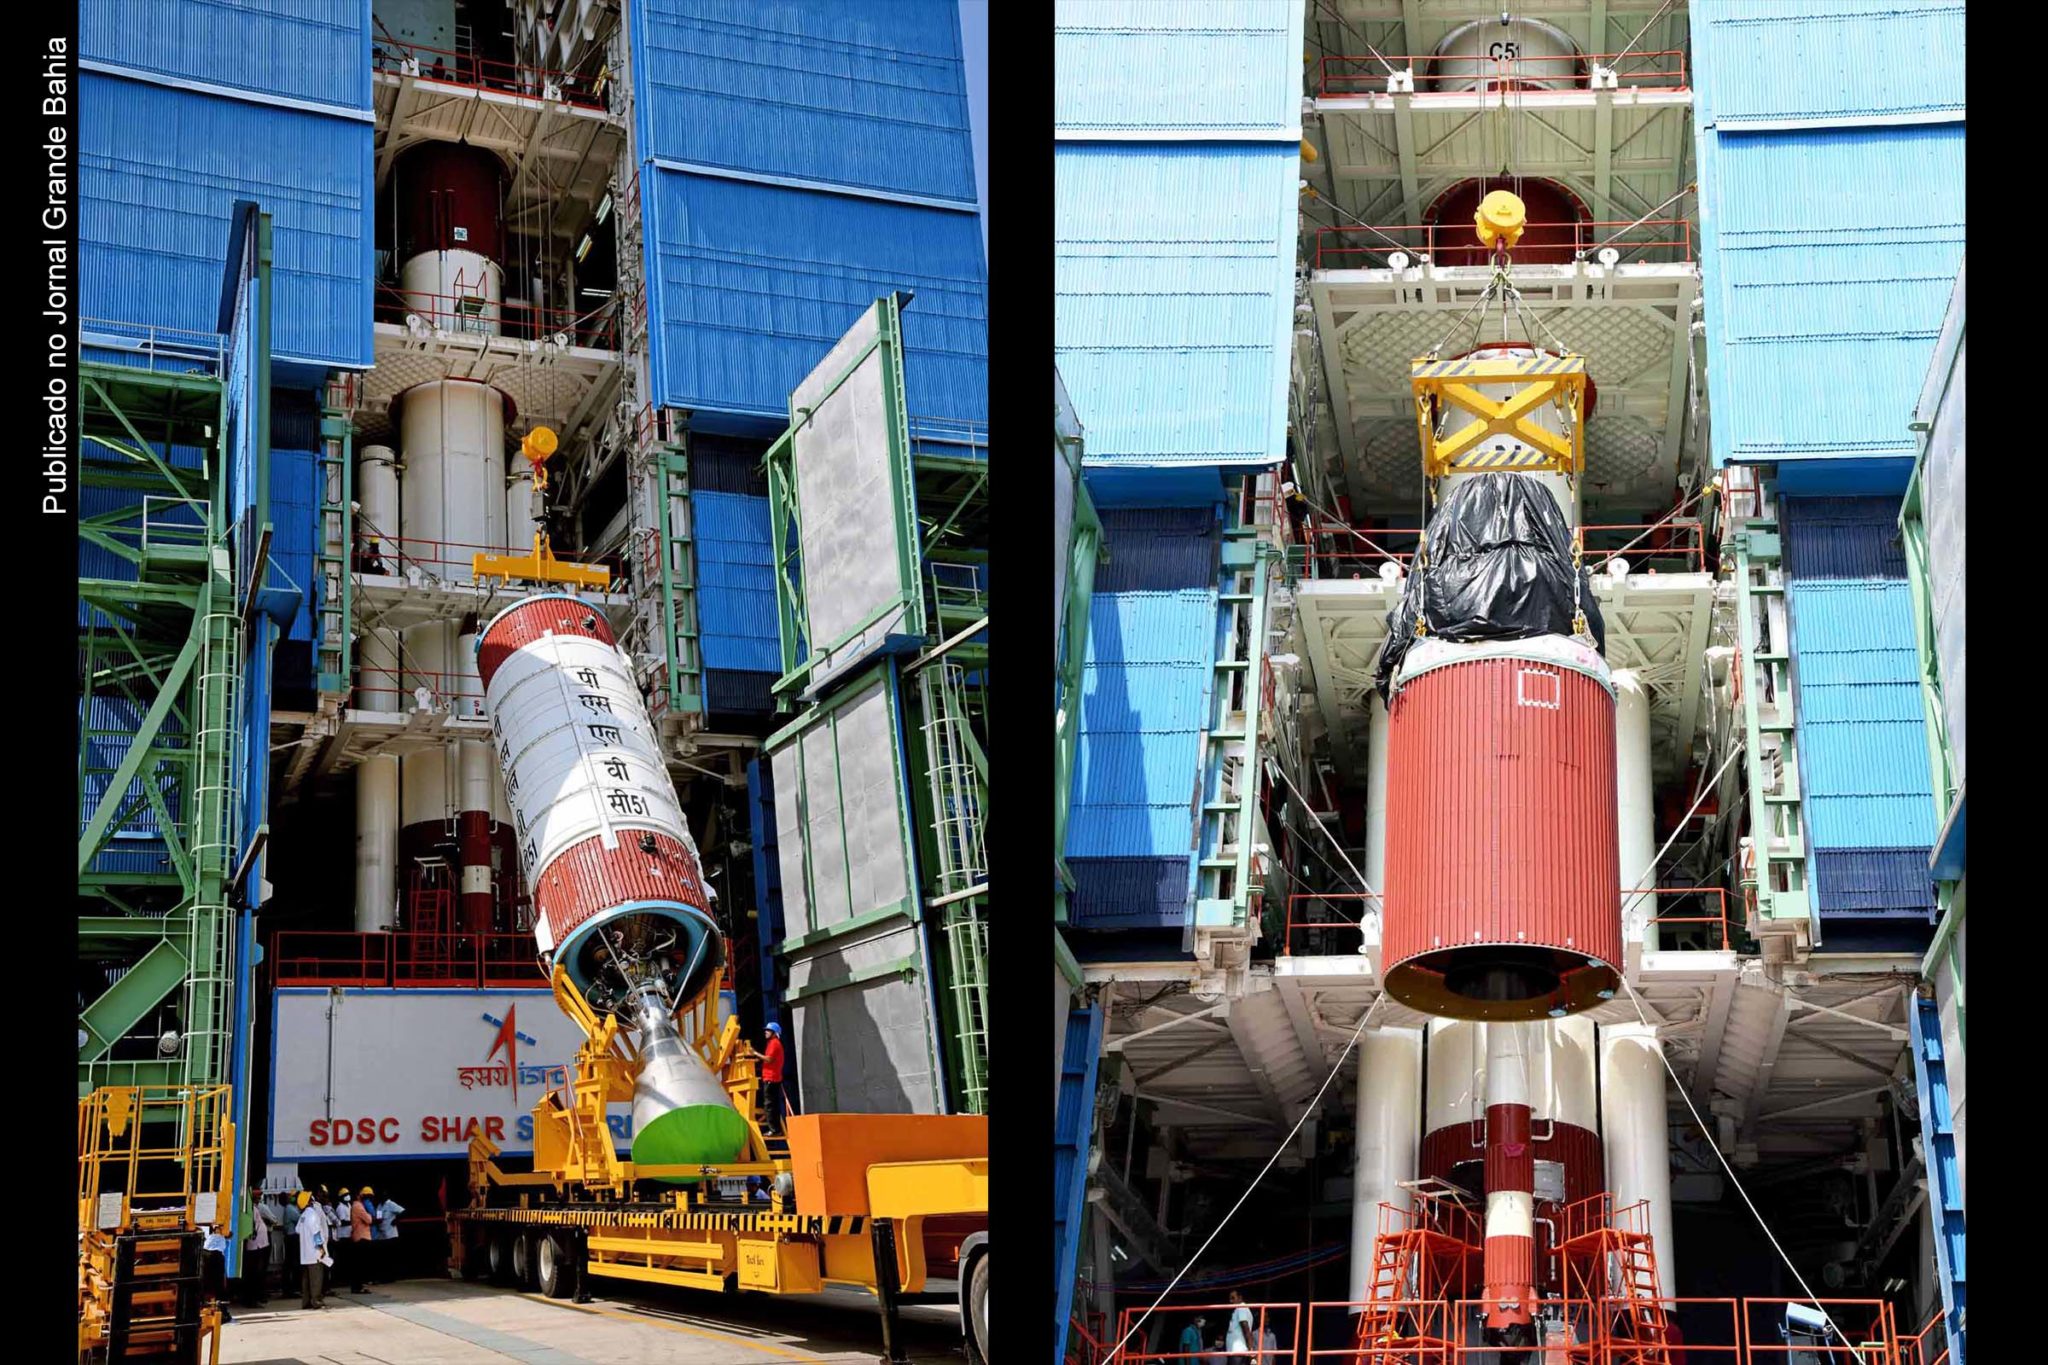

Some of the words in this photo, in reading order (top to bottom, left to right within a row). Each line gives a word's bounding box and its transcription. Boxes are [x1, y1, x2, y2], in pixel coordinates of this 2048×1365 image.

[577, 667, 600, 689] पी
[578, 694, 613, 716] एस
[587, 724, 623, 747] एल
[604, 756, 630, 781] वी
[457, 1060, 508, 1091] इसरो
[309, 1117, 400, 1146] SDSC
[421, 1116, 506, 1142] SHAR
